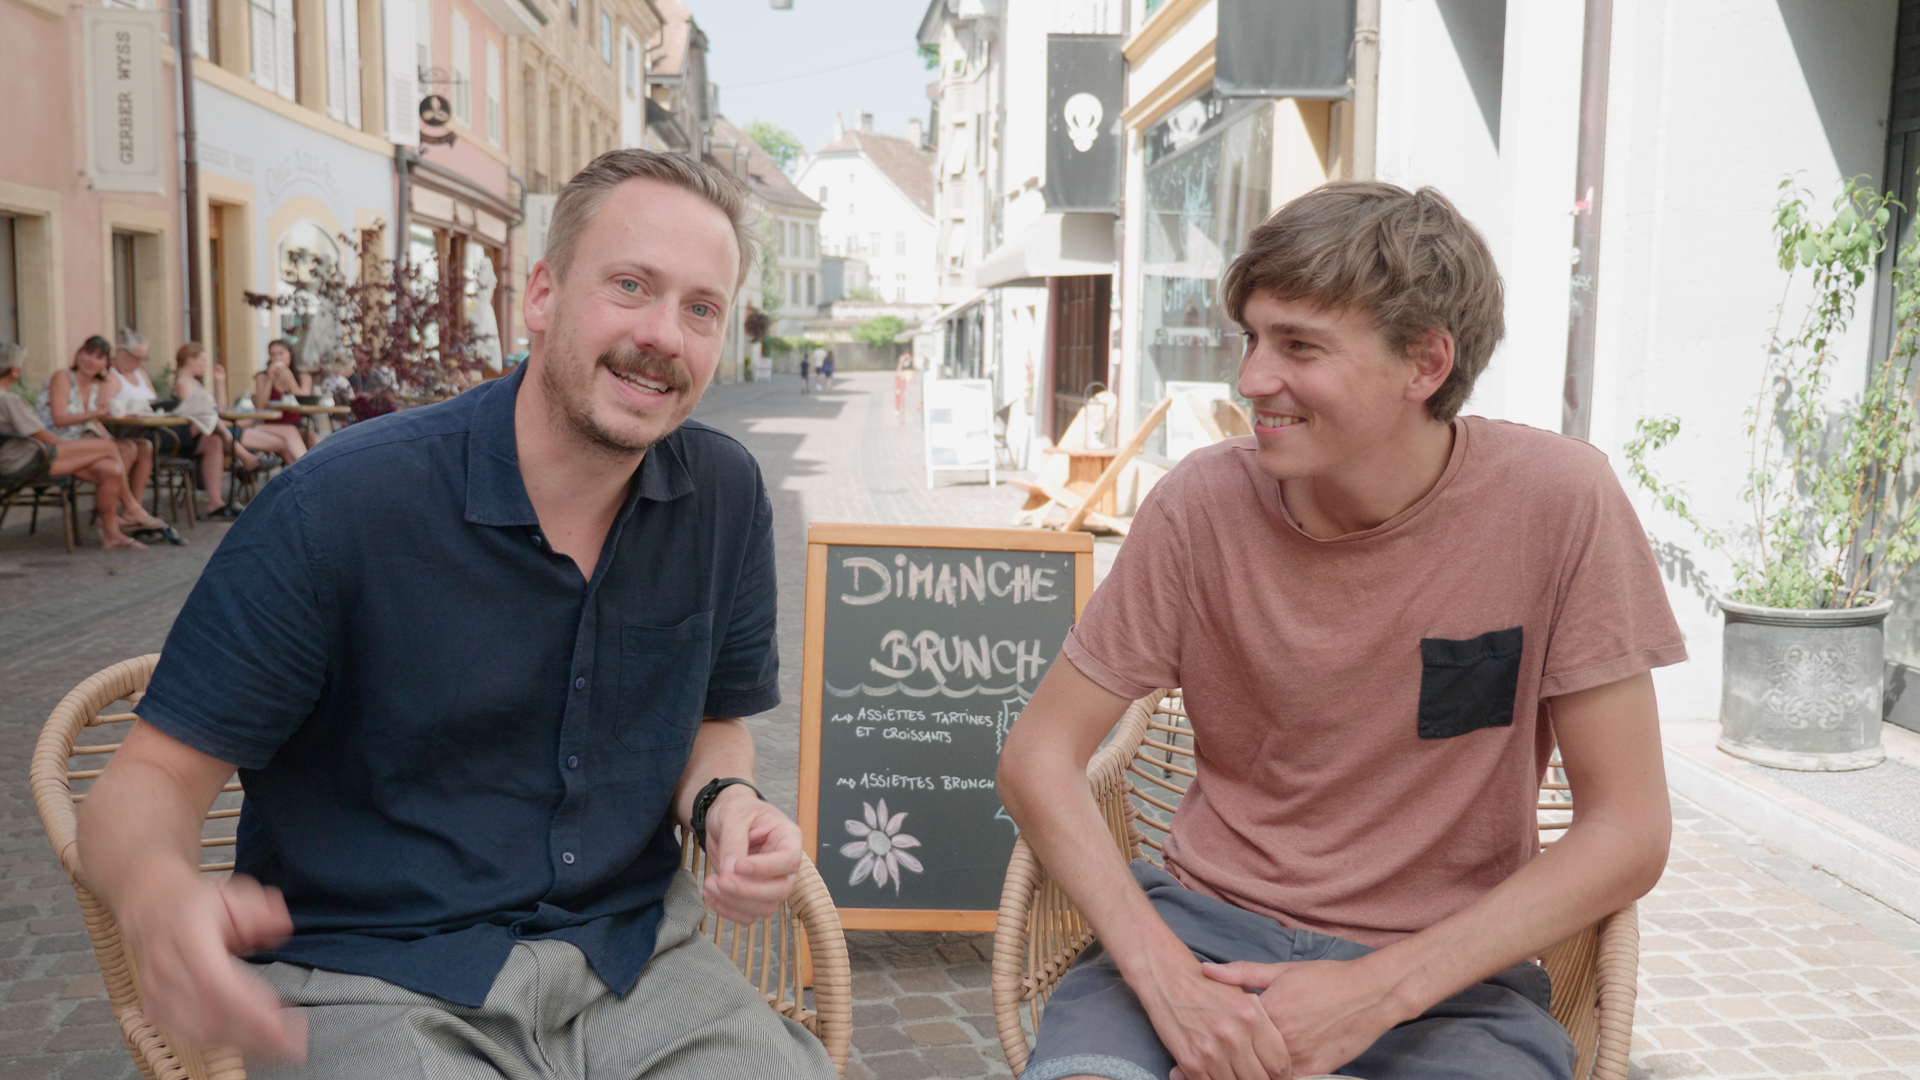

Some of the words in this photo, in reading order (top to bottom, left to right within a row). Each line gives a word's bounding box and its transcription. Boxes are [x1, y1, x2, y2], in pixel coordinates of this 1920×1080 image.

[116, 31, 131, 80] WYSS
[118, 91, 135, 165] GERBER
[870, 629, 1047, 685] BRUNCH
[856, 726, 876, 737] ET
[941, 775, 995, 790] BRUNCH
